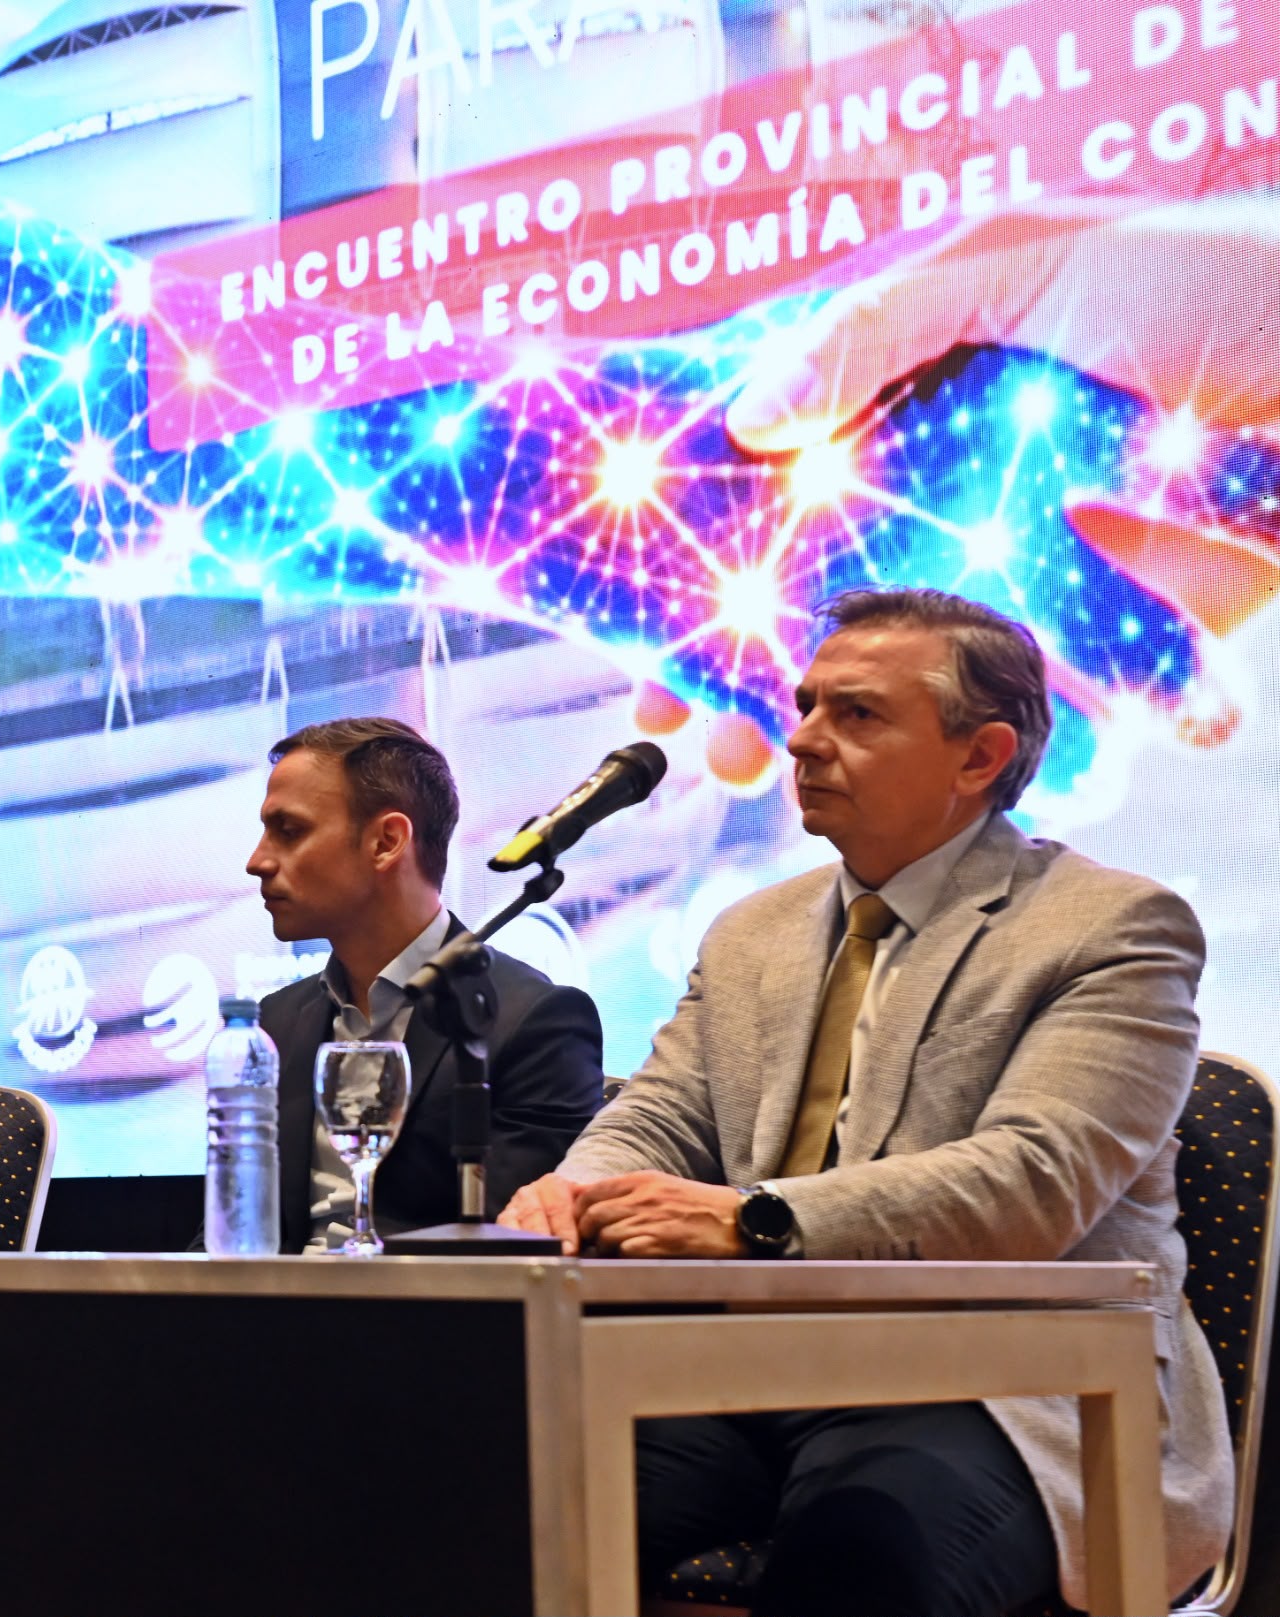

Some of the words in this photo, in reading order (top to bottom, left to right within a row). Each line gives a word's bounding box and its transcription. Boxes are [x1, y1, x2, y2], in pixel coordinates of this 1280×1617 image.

[220, 178, 582, 322] ENCUENTRO
[610, 31, 1091, 216] PROVINCIAL
[1132, 0, 1239, 70] DE
[291, 323, 360, 385] DE
[386, 300, 455, 361] LA
[482, 186, 866, 337] ECONOMÍA
[901, 145, 1043, 231] DEL
[1081, 79, 1279, 182] CON
